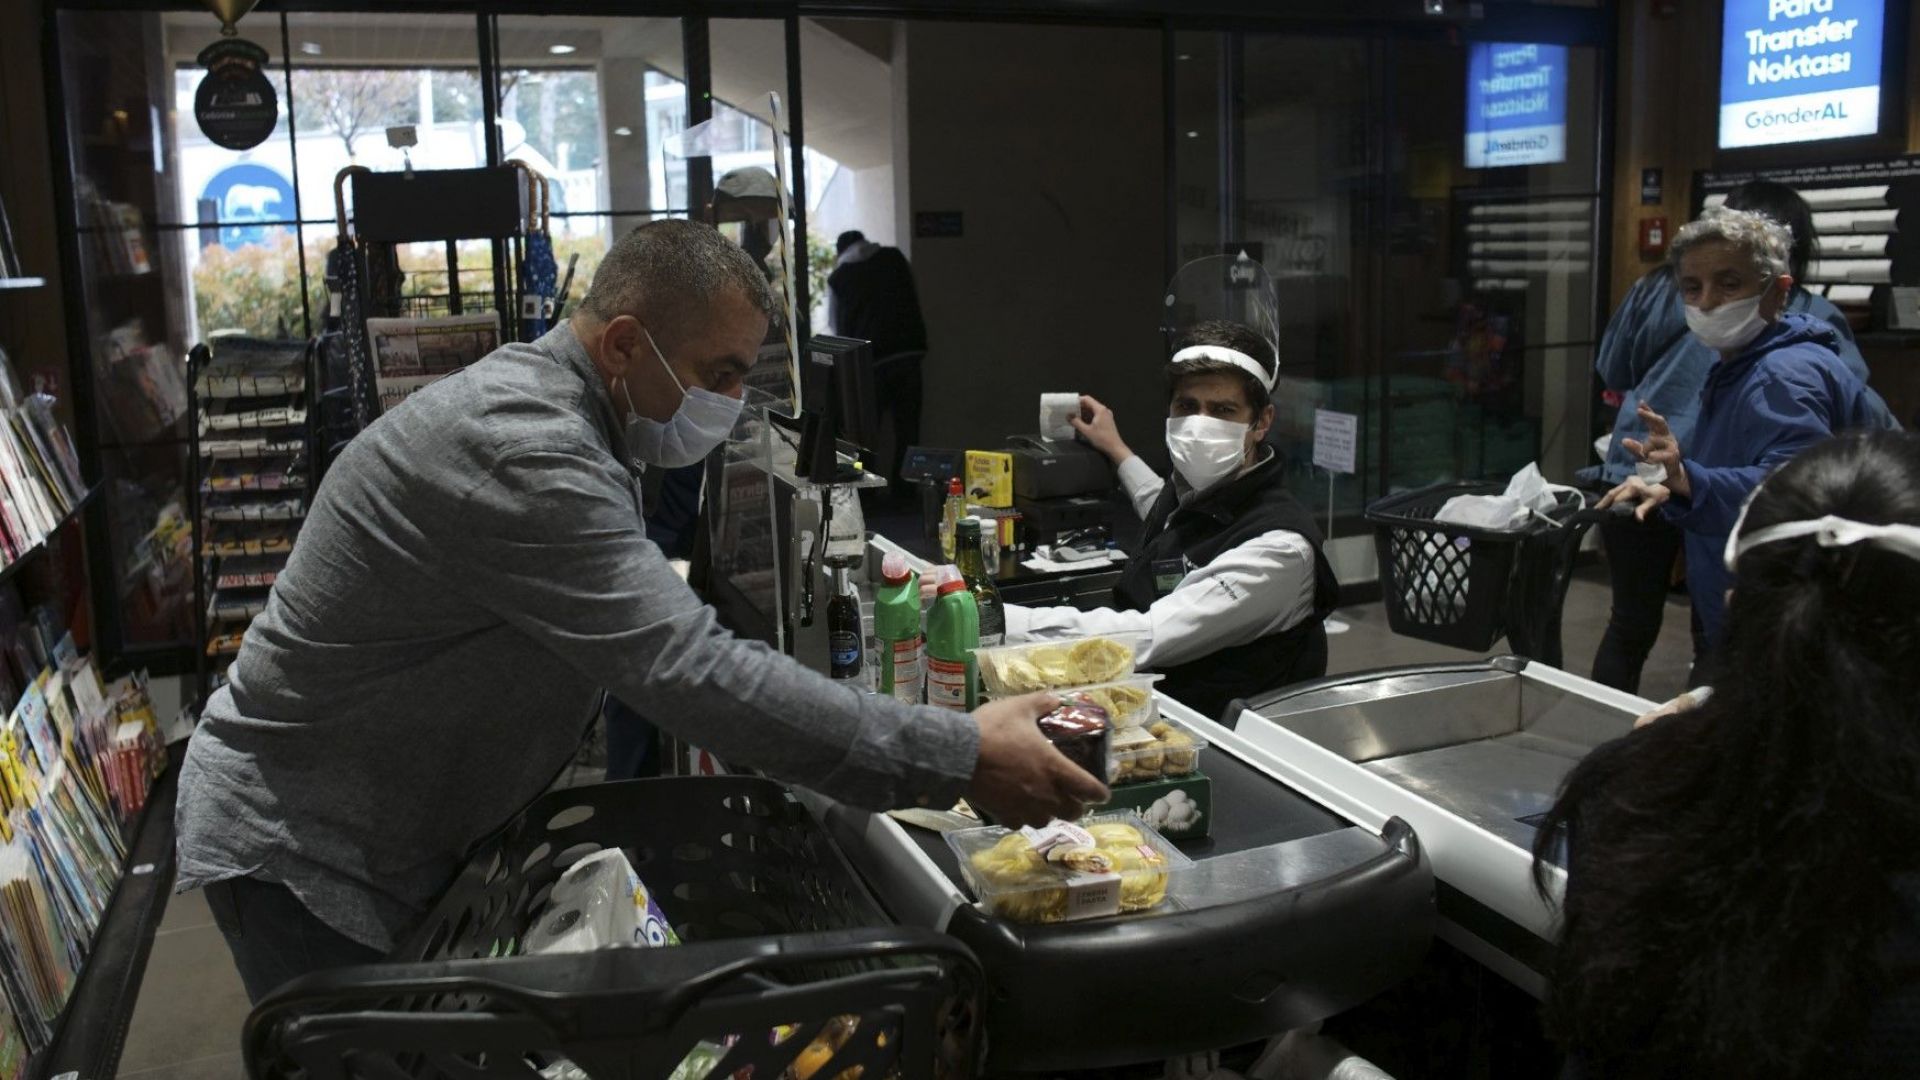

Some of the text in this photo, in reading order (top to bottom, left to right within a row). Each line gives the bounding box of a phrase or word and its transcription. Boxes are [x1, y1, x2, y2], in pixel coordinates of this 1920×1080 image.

[1768, 0, 1834, 21] Para
[1745, 17, 1858, 55] Transfer
[1747, 51, 1851, 85] Noktası
[1745, 102, 1848, 129] GönderAL
